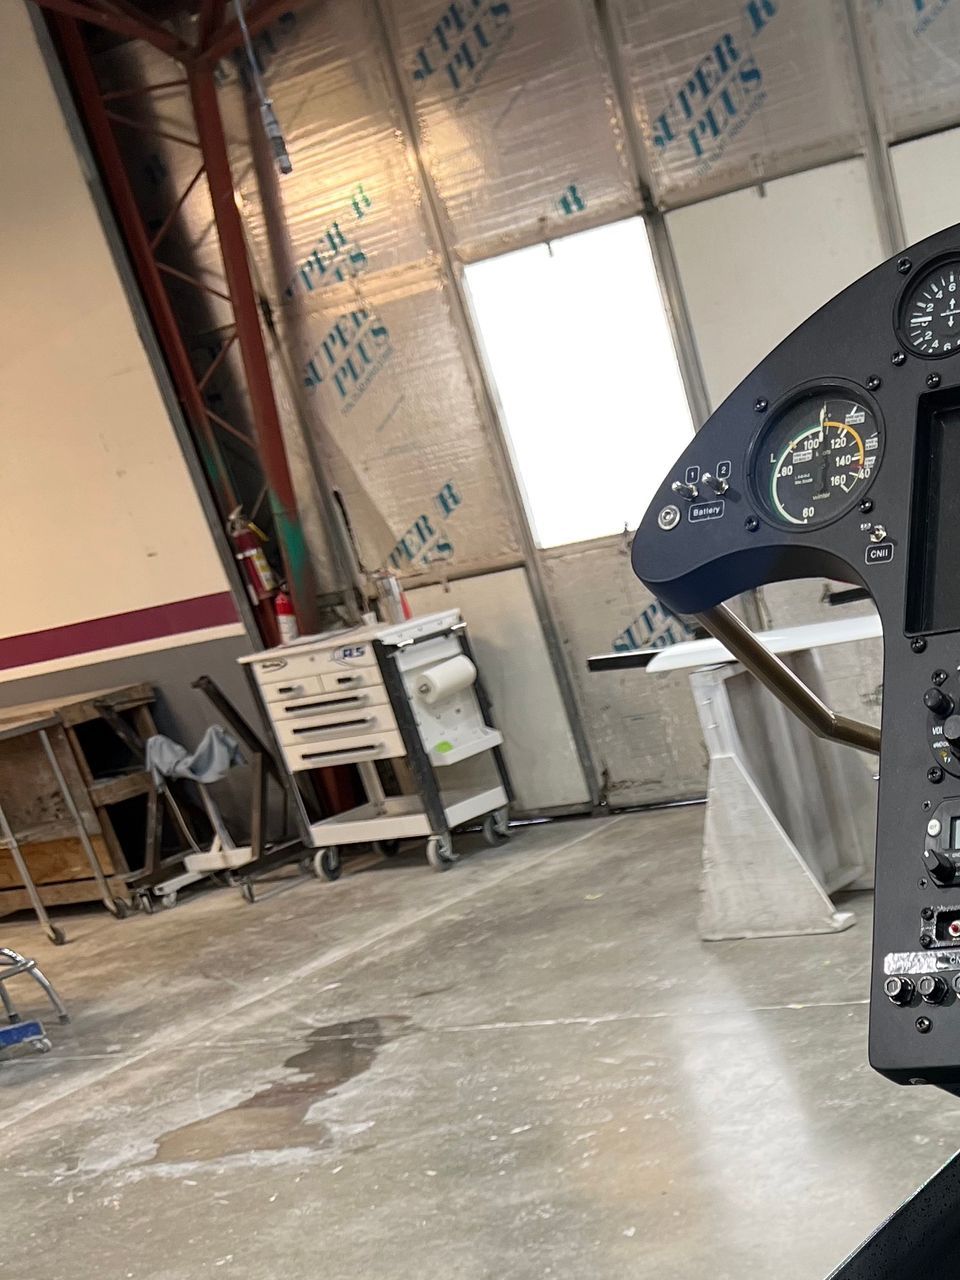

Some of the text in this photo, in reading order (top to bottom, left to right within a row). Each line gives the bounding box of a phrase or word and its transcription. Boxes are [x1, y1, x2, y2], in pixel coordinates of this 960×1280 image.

[688, 56, 763, 157] PLUS
[935, 290, 943, 299] 4
[948, 282, 956, 292] 6
[926, 303, 934, 312] 2
[924, 331, 933, 340] 2
[931, 339, 939, 348] 4
[803, 439, 819, 451] 100
[830, 438, 847, 449] 120
[835, 454, 852, 467] 140
[721, 466, 726, 474] 2
[781, 465, 793, 477] 80
[830, 474, 847, 486] 160
[693, 506, 720, 517] Battery
[802, 506, 815, 518] 60
